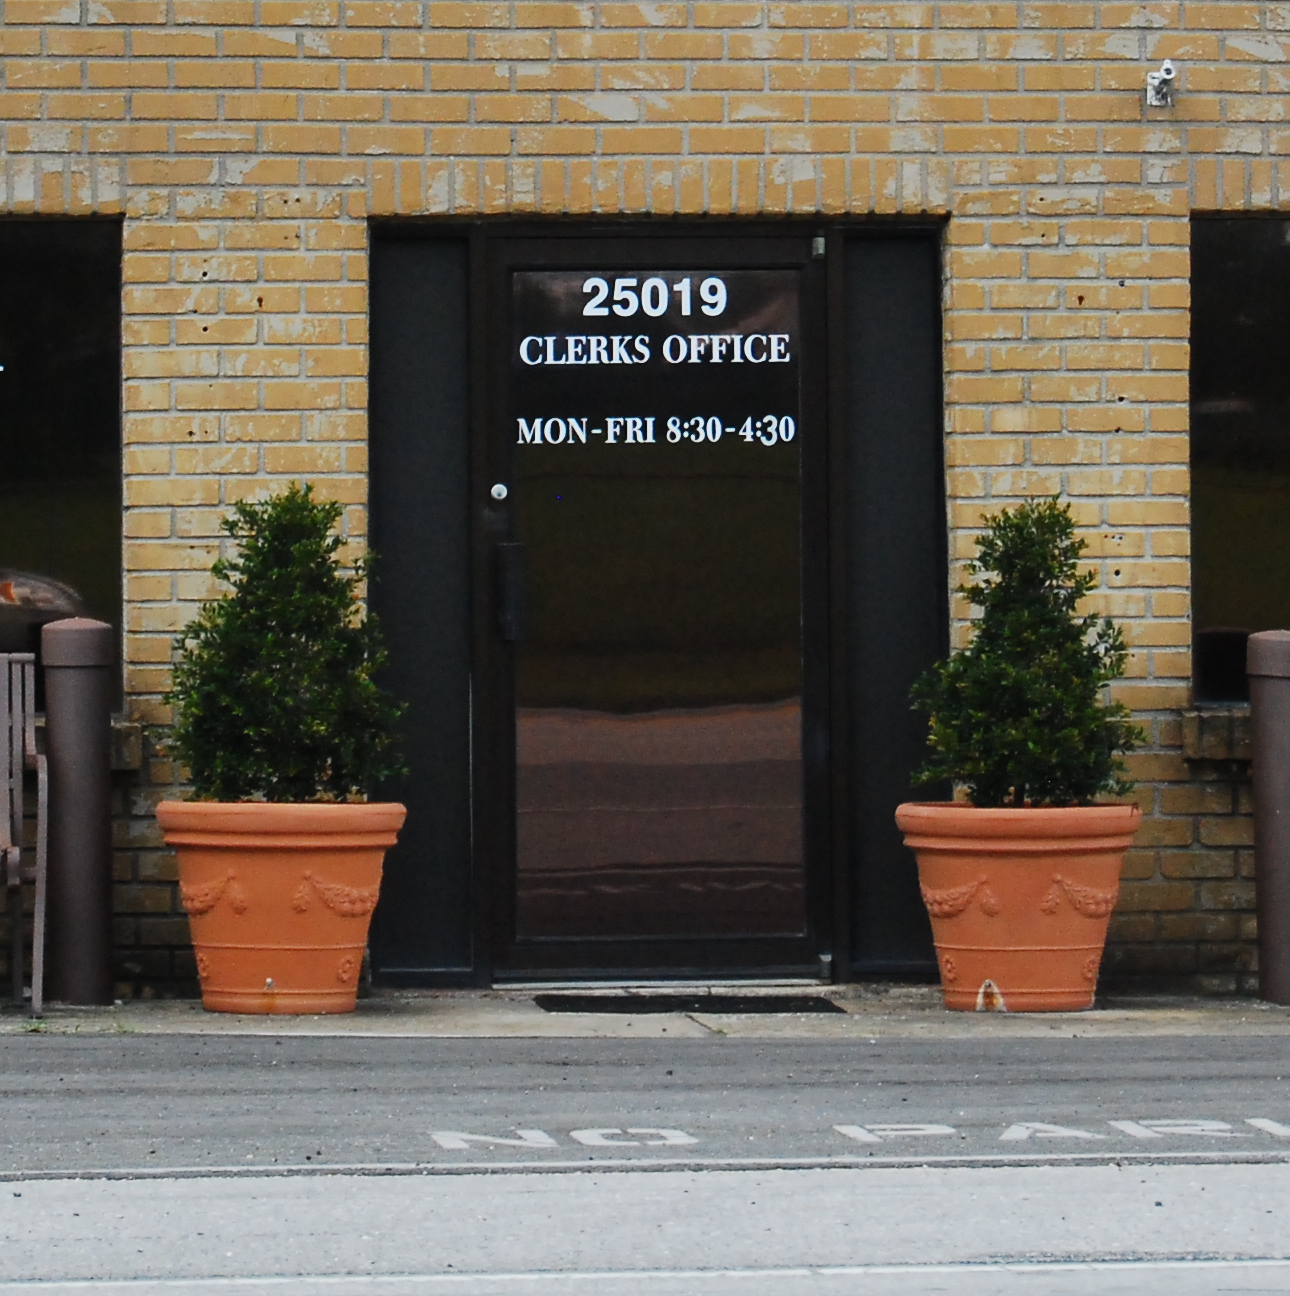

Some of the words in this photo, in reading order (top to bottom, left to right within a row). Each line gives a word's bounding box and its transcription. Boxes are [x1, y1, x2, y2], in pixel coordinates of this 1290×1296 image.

[582, 277, 727, 317] 25019
[519, 335, 650, 365] CLERKS
[662, 334, 791, 364] OFFICE
[516, 417, 656, 444] MON-FRI
[666, 415, 796, 446] 8:30-4:30
[427, 1127, 699, 1150] NO
